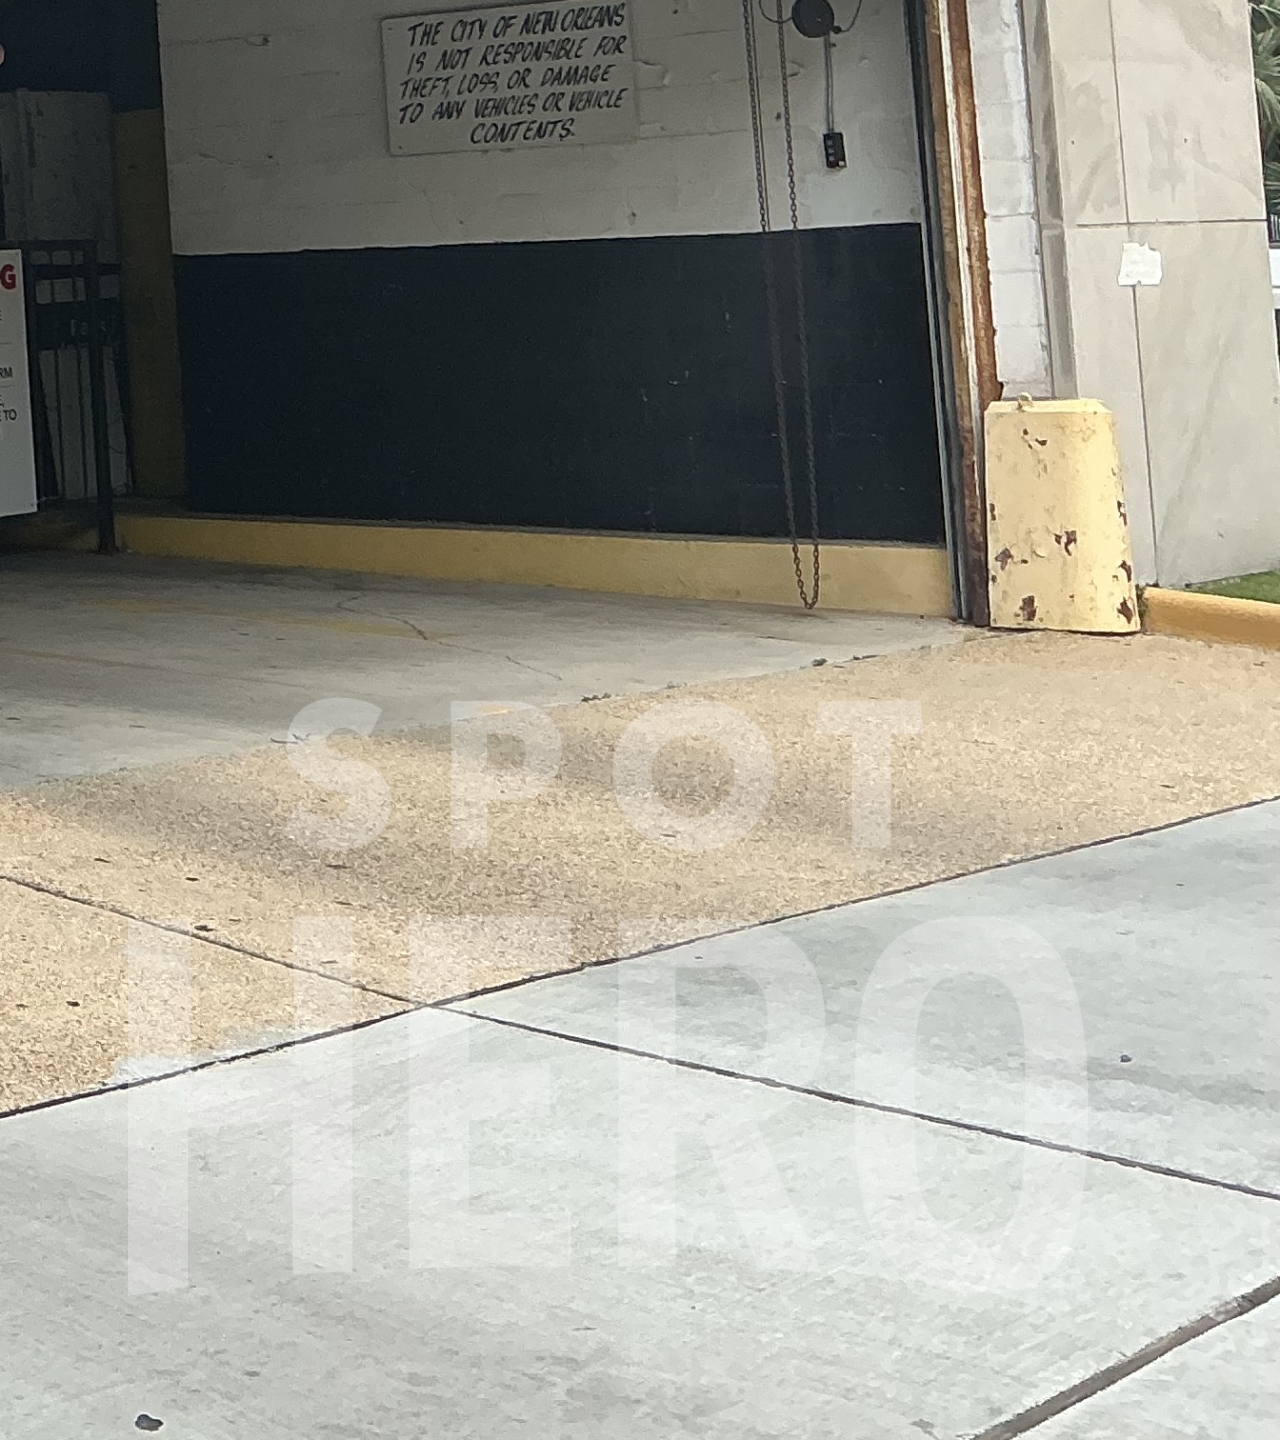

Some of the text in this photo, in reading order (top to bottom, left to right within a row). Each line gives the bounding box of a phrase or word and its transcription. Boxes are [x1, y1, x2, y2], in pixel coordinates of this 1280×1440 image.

[408, 2, 626, 48] THE CITY OF NEW ORLEANS
[407, 34, 627, 75] IS NOT RESPONSIBLE FOR
[507, 67, 533, 90] OR
[540, 63, 616, 88] DAMAGE
[399, 87, 628, 125] TO ANY VEHICLES OR VEHICLE
[3, 409, 18, 421] TO
